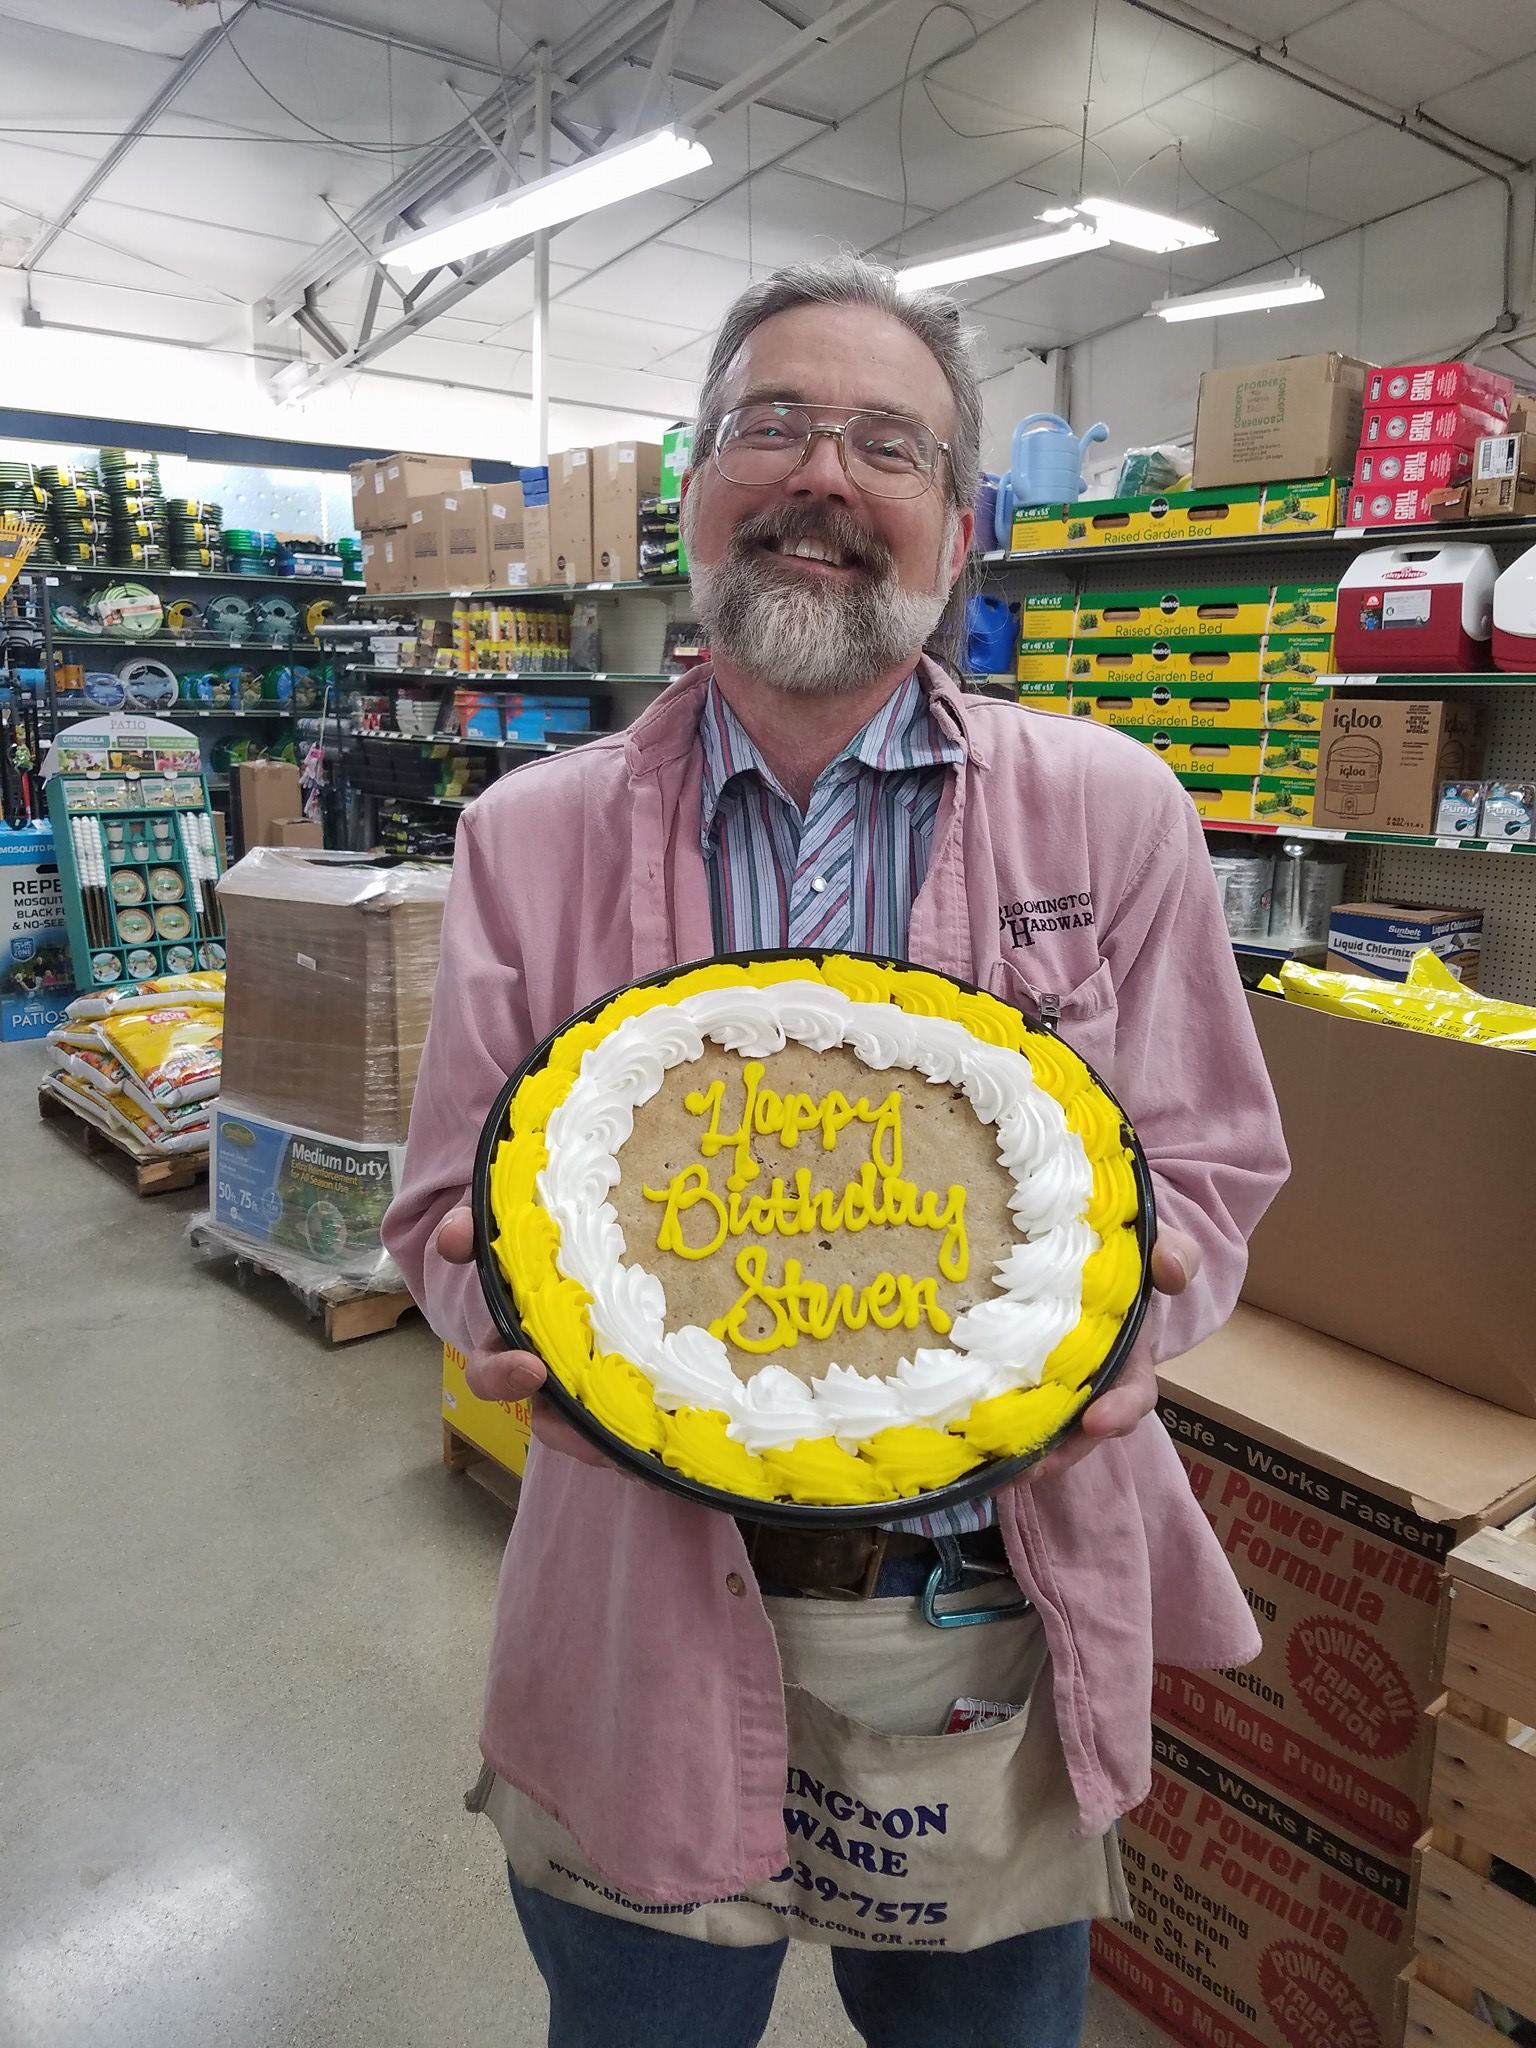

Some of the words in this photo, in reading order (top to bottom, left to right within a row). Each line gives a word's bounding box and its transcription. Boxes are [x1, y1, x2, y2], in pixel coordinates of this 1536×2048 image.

[1410, 371, 1427, 401] GRILL
[1409, 412, 1426, 441] GRILL
[1404, 453, 1420, 481] GRILL
[1395, 491, 1410, 520] GRILL
[1104, 531, 1140, 544] Raised
[1144, 528, 1184, 541] Garden
[1188, 524, 1212, 537] Bed
[1115, 625, 1151, 636] Raised
[1154, 624, 1195, 635] Garden
[1199, 623, 1222, 634] Bed
[1108, 671, 1142, 681] Raised
[1146, 671, 1186, 681] Garden
[1190, 671, 1214, 681] Bed
[111, 720, 147, 730] PATIO
[1109, 714, 1144, 725] Raised
[1147, 714, 1188, 725] Garden
[1191, 715, 1215, 727] Bed
[1333, 708, 1382, 734] igloo
[1167, 761, 1187, 771] den
[1191, 761, 1214, 772] Bed
[1339, 765, 1366, 779] igloo
[1441, 804, 1477, 816] Pump
[1487, 805, 1527, 817] Pump
[0, 845, 46, 854] MOSQUITO
[12, 879, 61, 896] REPE
[14, 896, 63, 907] MOSQUIT
[12, 922, 20, 930] &
[24, 918, 64, 929] NO-SEE
[17, 908, 53, 919] BLACK
[1000, 892, 1091, 931] LOOMINGTO
[1007, 912, 1094, 949] HARDWAR
[1388, 924, 1422, 937] Sunbelt
[1333, 937, 1363, 953] Liquid
[1366, 942, 1416, 958] Chlorinize
[1381, 1017, 1410, 1029] Covers
[1411, 1024, 1425, 1033] up
[1401, 1013, 1430, 1025] HURT
[684, 1061, 901, 1181] Happy
[292, 1142, 342, 1172] Medium
[345, 1157, 389, 1181] Duty
[643, 1163, 969, 1282] Birthday
[708, 1245, 952, 1353] Steven
[1162, 1408, 1216, 1447] Safe
[1246, 1446, 1331, 1502] Works
[1340, 1489, 1444, 1554] Faster!
[1220, 1471, 1345, 1557] Power
[1352, 1538, 1440, 1606] with
[1225, 1518, 1384, 1626] Formula
[1300, 1626, 1414, 1726] POWERFUL
[1312, 1655, 1387, 1728] TRIPLE
[1298, 1675, 1381, 1749] ACTION
[1181, 1679, 1206, 1714] To
[1214, 1699, 1275, 1754] Mole
[1282, 1740, 1410, 1831] Problems
[786, 1766, 948, 1840] INGTON
[1152, 1738, 1189, 1769] afe
[1219, 1772, 1298, 1835] Works
[1306, 1826, 1401, 1896] Faster!
[783, 1808, 909, 1878] WARE
[1195, 1793, 1311, 1885] Power
[1319, 1871, 1403, 1946] with
[1151, 1862, 1169, 1884] or
[1173, 1873, 1250, 1941] Spraying
[1200, 1838, 1349, 1956] Formula
[1142, 1877, 1230, 1951] Protection
[871, 1932, 903, 1945] OR
[908, 1936, 947, 1946] .net
[1163, 1917, 1188, 1949] Sq.
[1195, 1938, 1217, 1969] Ft.
[1154, 1936, 1258, 2023] Satisfaction
[1161, 1982, 1185, 2017] To
[1192, 2012, 1245, 2048] Mol
[1270, 1994, 1332, 2048] ACTIO
